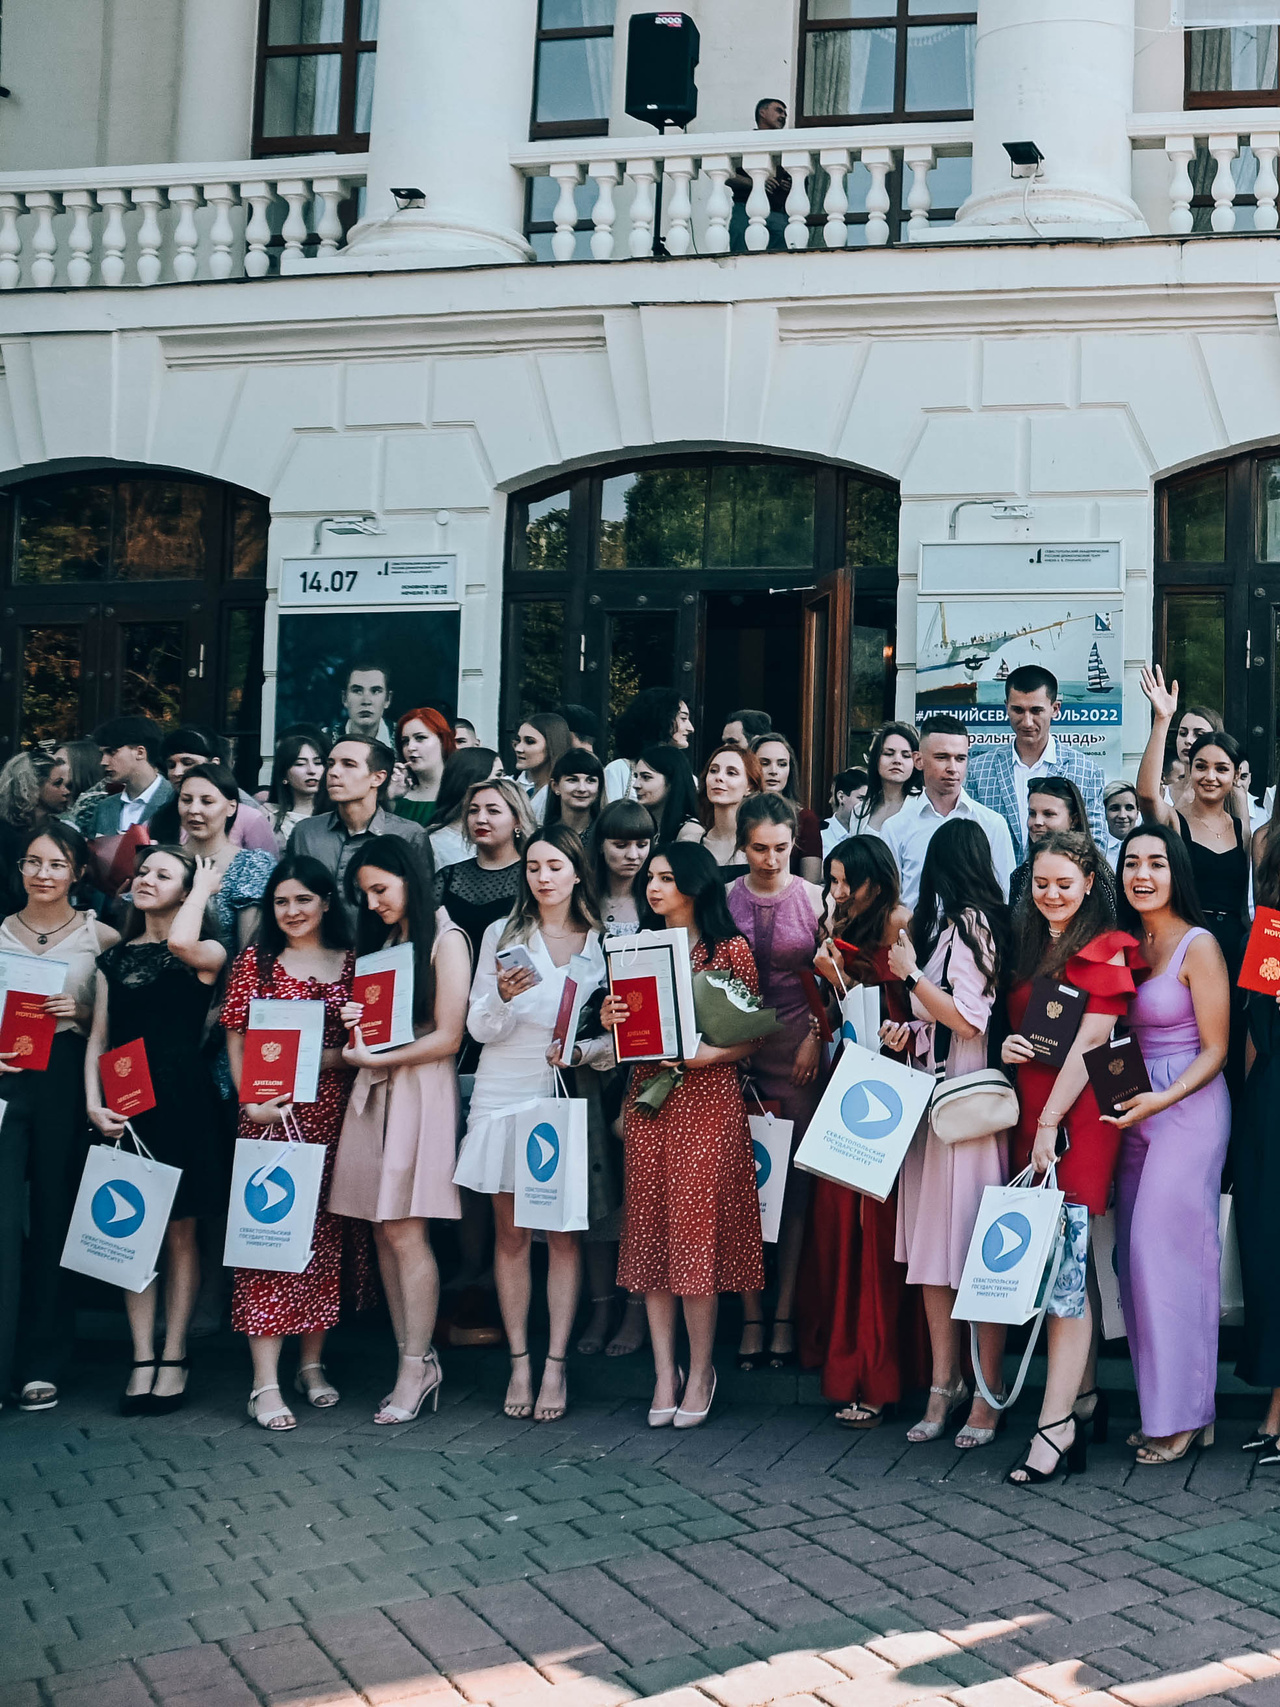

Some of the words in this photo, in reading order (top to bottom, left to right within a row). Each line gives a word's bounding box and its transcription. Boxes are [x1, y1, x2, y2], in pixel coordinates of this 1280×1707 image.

[300, 571, 358, 593] 14.07
[1029, 1033, 1059, 1047] ДИПЛОМ
[1111, 1086, 1140, 1103] ДИПЛОМ
[823, 1136, 883, 1164] ГОСУДАРСТВЕННЫЙ
[826, 1130, 886, 1158] СЕВАСТОПОЛЬСКИЙ
[830, 1145, 871, 1166] УНИВЕРСИТЕТ
[971, 1284, 1017, 1292] ГОСУДАРСТВЕННЫЙ
